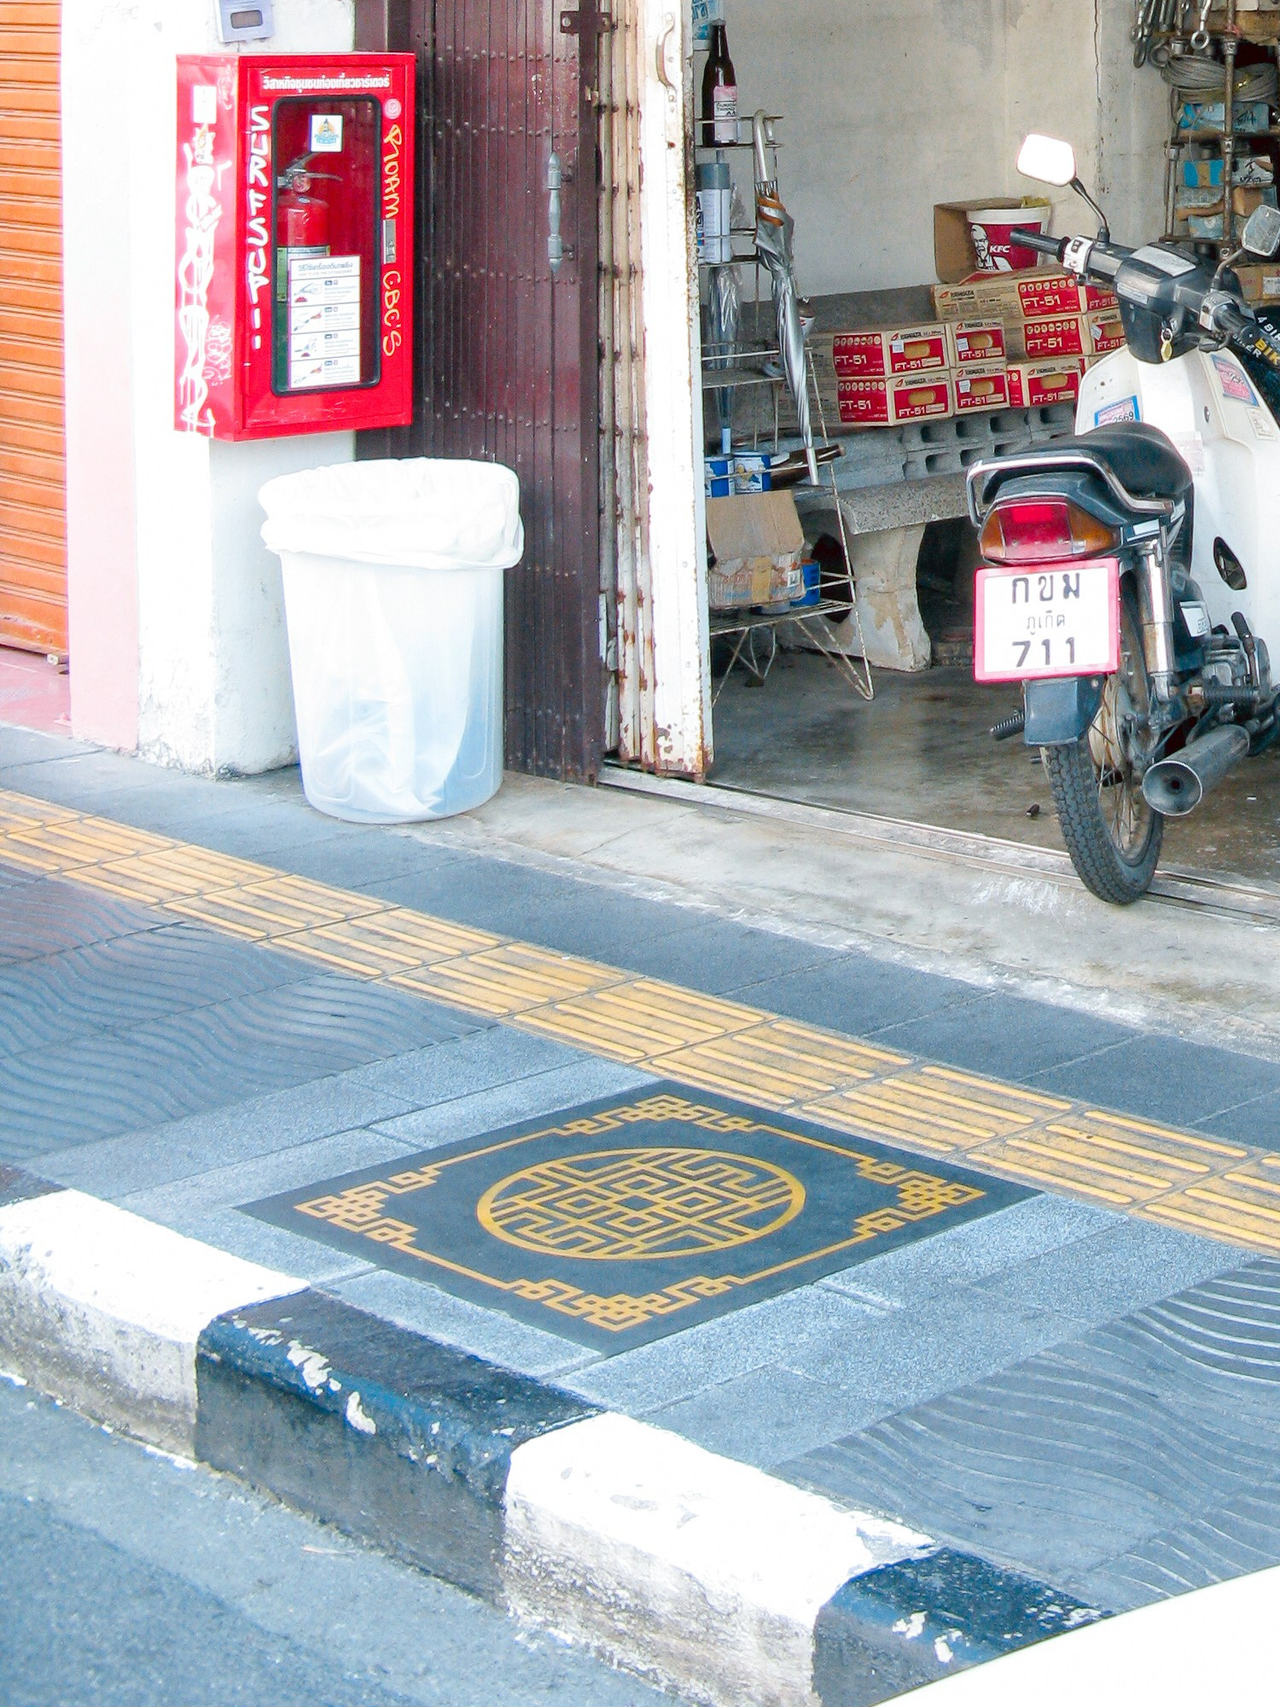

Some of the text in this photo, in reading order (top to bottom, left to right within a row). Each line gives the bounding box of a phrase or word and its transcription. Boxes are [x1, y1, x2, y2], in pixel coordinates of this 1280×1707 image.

[989, 243, 1011, 254] KFC
[1022, 295, 1061, 309] FT-51
[1089, 297, 1111, 309] FT-51
[1026, 337, 1063, 350] FT-51
[1097, 338, 1120, 350] FT-51
[834, 355, 868, 365] FT-51
[961, 350, 985, 360] FT-51
[894, 362, 922, 371] FT-51
[960, 396, 986, 407] FT-51
[1032, 392, 1058, 403] FT-51
[840, 400, 872, 410] FT-51
[898, 407, 925, 417] FT-51
[1011, 573, 1080, 604] กขม
[1011, 636, 1075, 668] 711
